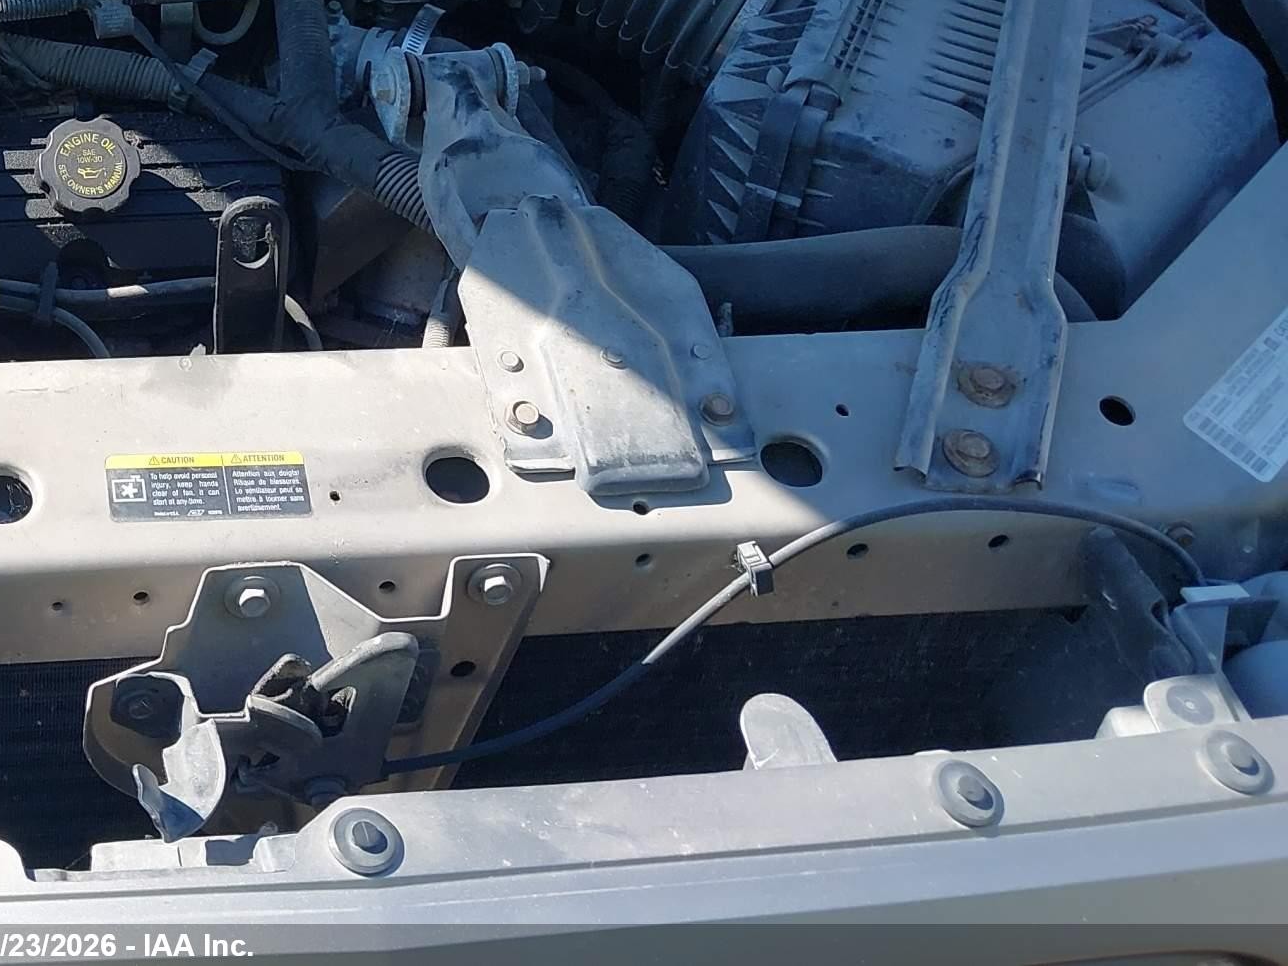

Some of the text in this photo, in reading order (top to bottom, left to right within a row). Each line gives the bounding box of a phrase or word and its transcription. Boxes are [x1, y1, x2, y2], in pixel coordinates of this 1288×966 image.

[60, 132, 117, 157] ENGINE OIL
[77, 155, 103, 163] 10W-30
[58, 160, 124, 195] SEE OWNER'S MANUAL
[160, 456, 195, 464] CAUTION
[242, 454, 285, 462] ATTENTION
[150, 471, 218, 481] To help avoid personal
[232, 470, 260, 478] Attention
[263, 470, 276, 478] aux
[176, 480, 193, 489] keep
[199, 480, 219, 488] hands
[233, 478, 255, 487] Risque
[152, 489, 168, 497] clear
[172, 488, 179, 496] of
[279, 486, 293, 494] peut
[153, 498, 168, 506] start
[175, 499, 188, 507] any
[236, 495, 256, 503] mettre
[265, 494, 288, 502] tourner
